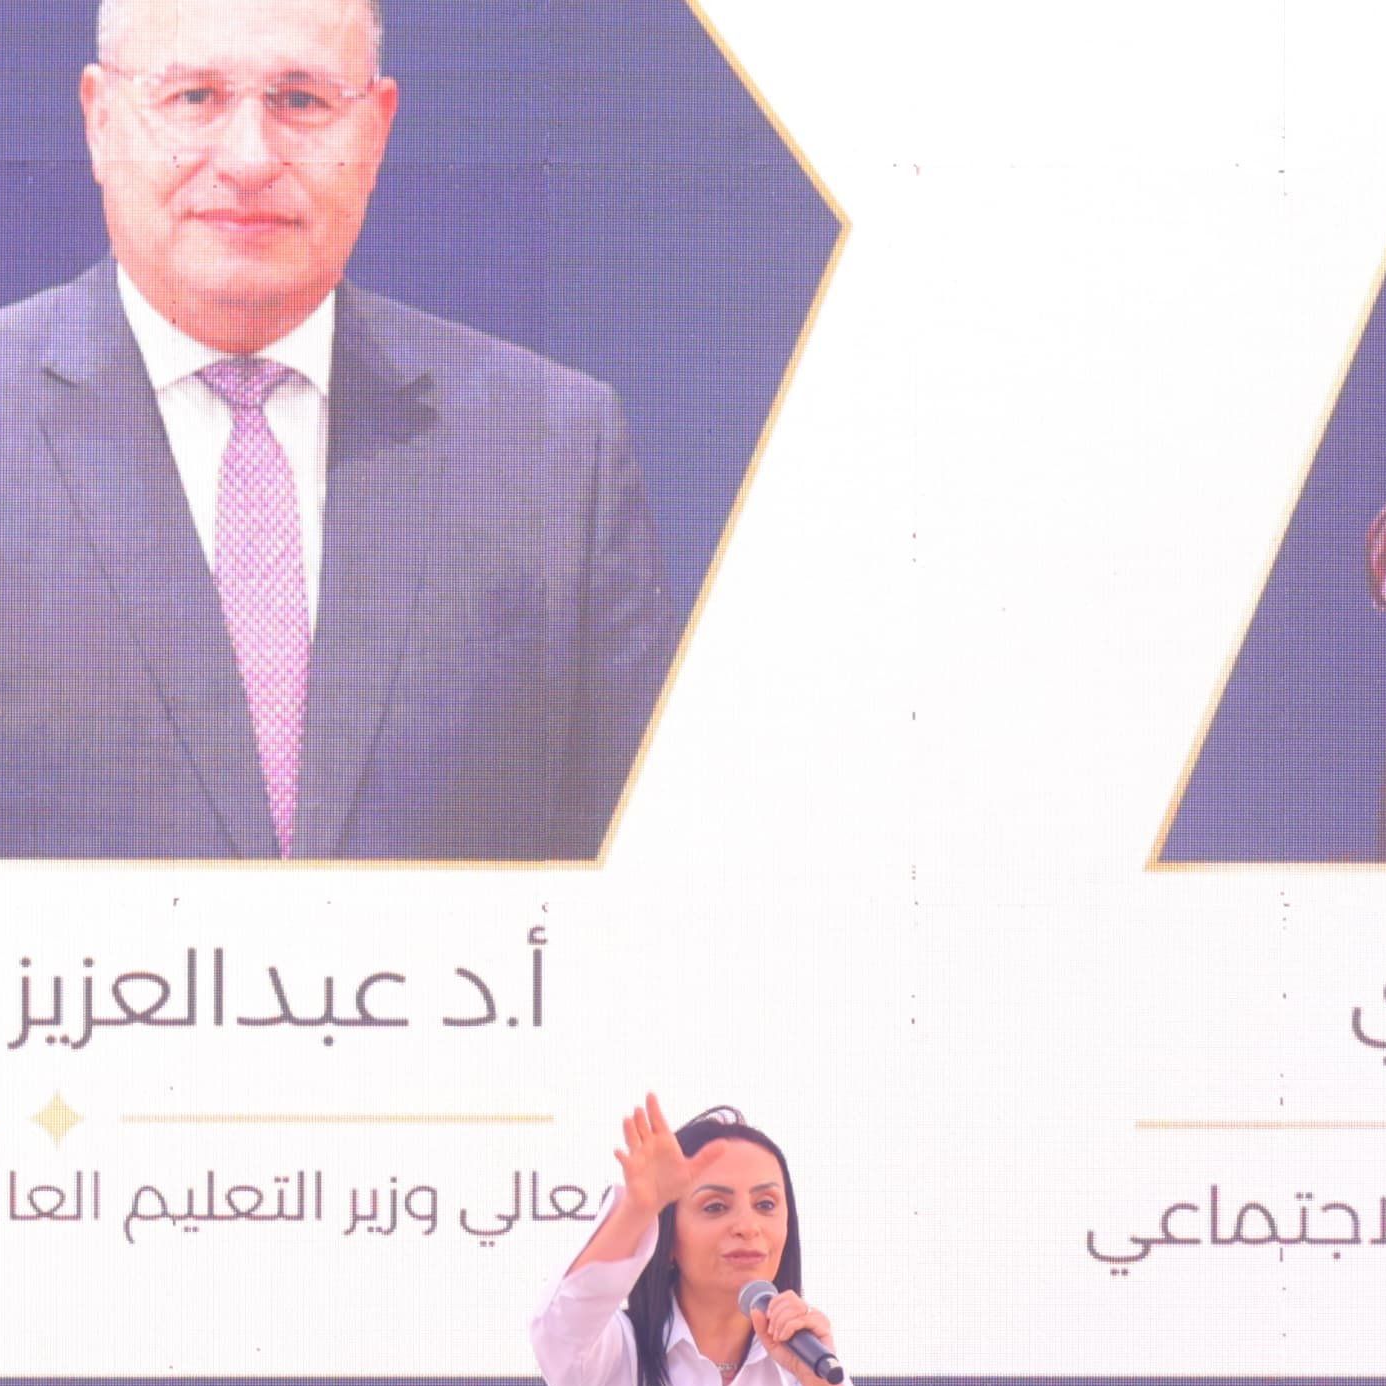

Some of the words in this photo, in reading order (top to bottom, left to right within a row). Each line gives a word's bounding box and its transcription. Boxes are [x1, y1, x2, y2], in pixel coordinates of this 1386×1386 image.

[122, 1170, 323, 1245] التعليم
[343, 1176, 438, 1236] وزير
[459, 1170, 613, 1247] عالي
